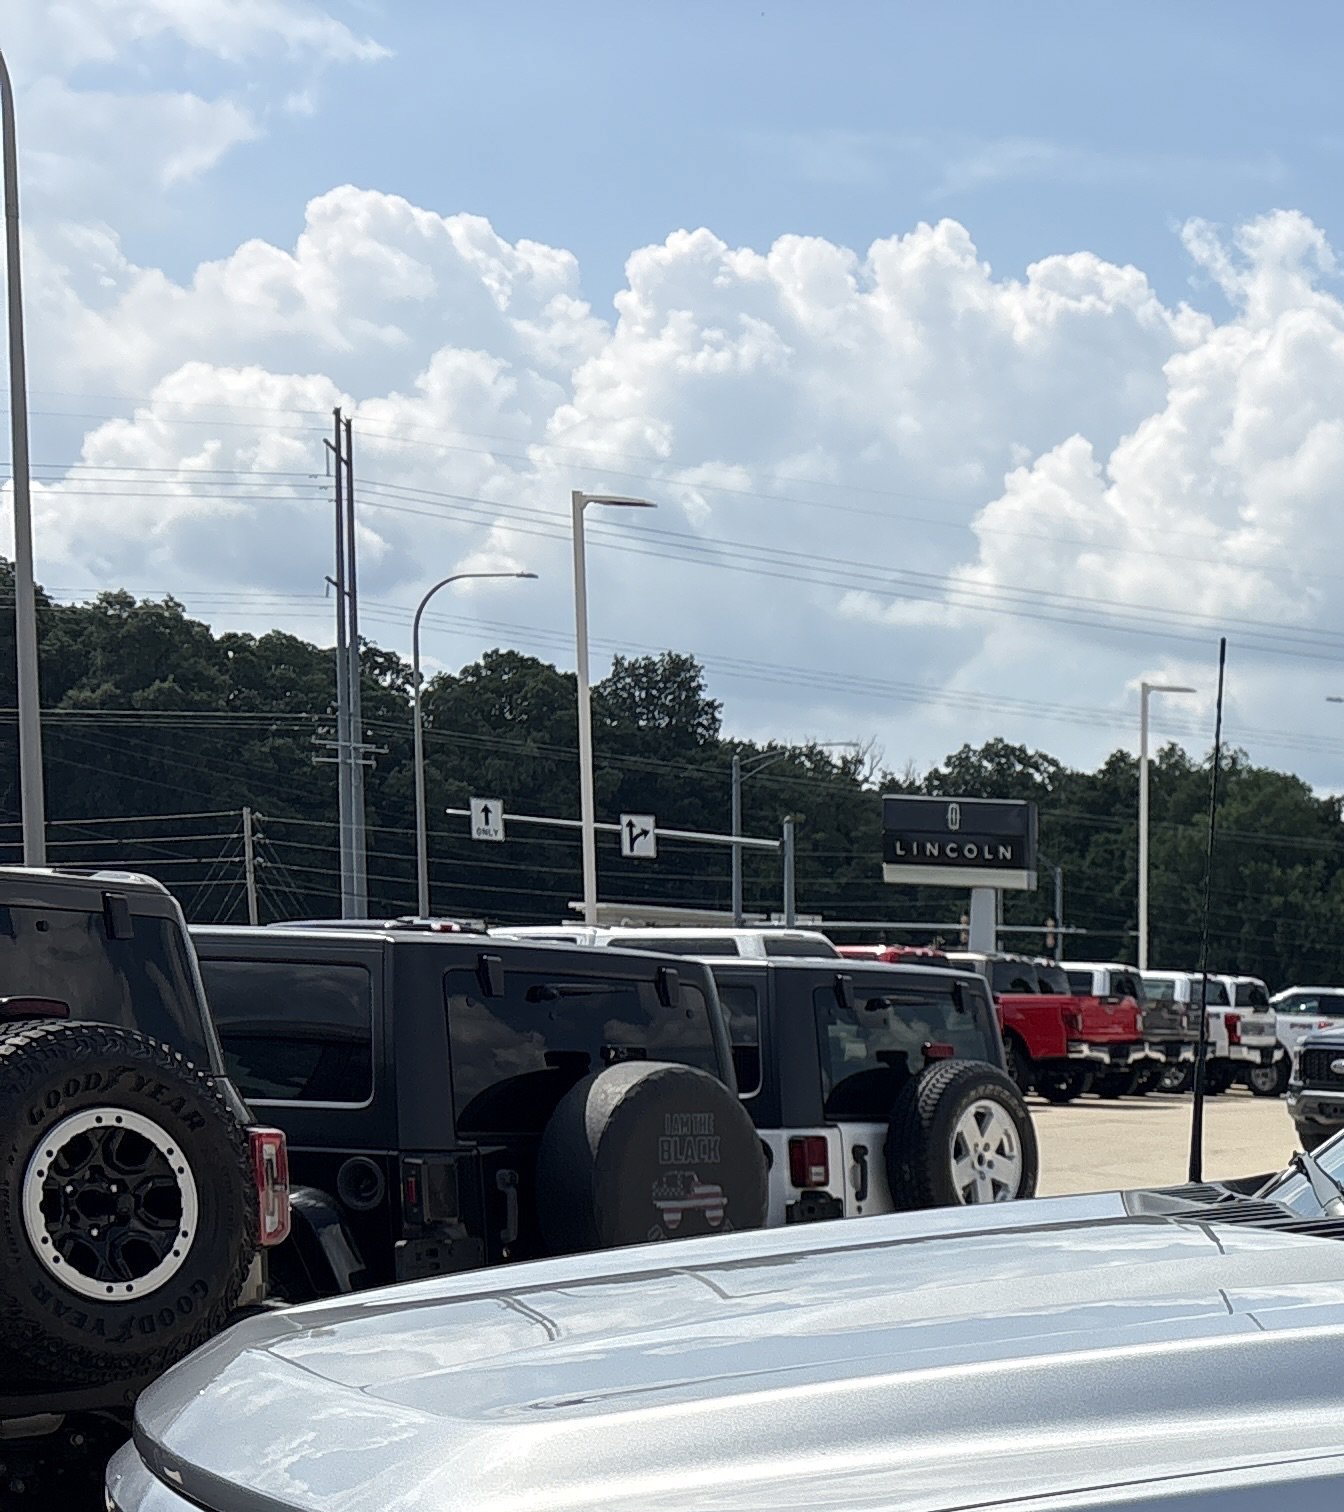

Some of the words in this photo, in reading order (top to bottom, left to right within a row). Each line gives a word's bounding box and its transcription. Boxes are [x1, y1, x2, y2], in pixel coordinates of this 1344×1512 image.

[476, 827, 499, 838] ONLY
[895, 839, 1012, 861] LINCOLN
[658, 1136, 721, 1165] BLACK
